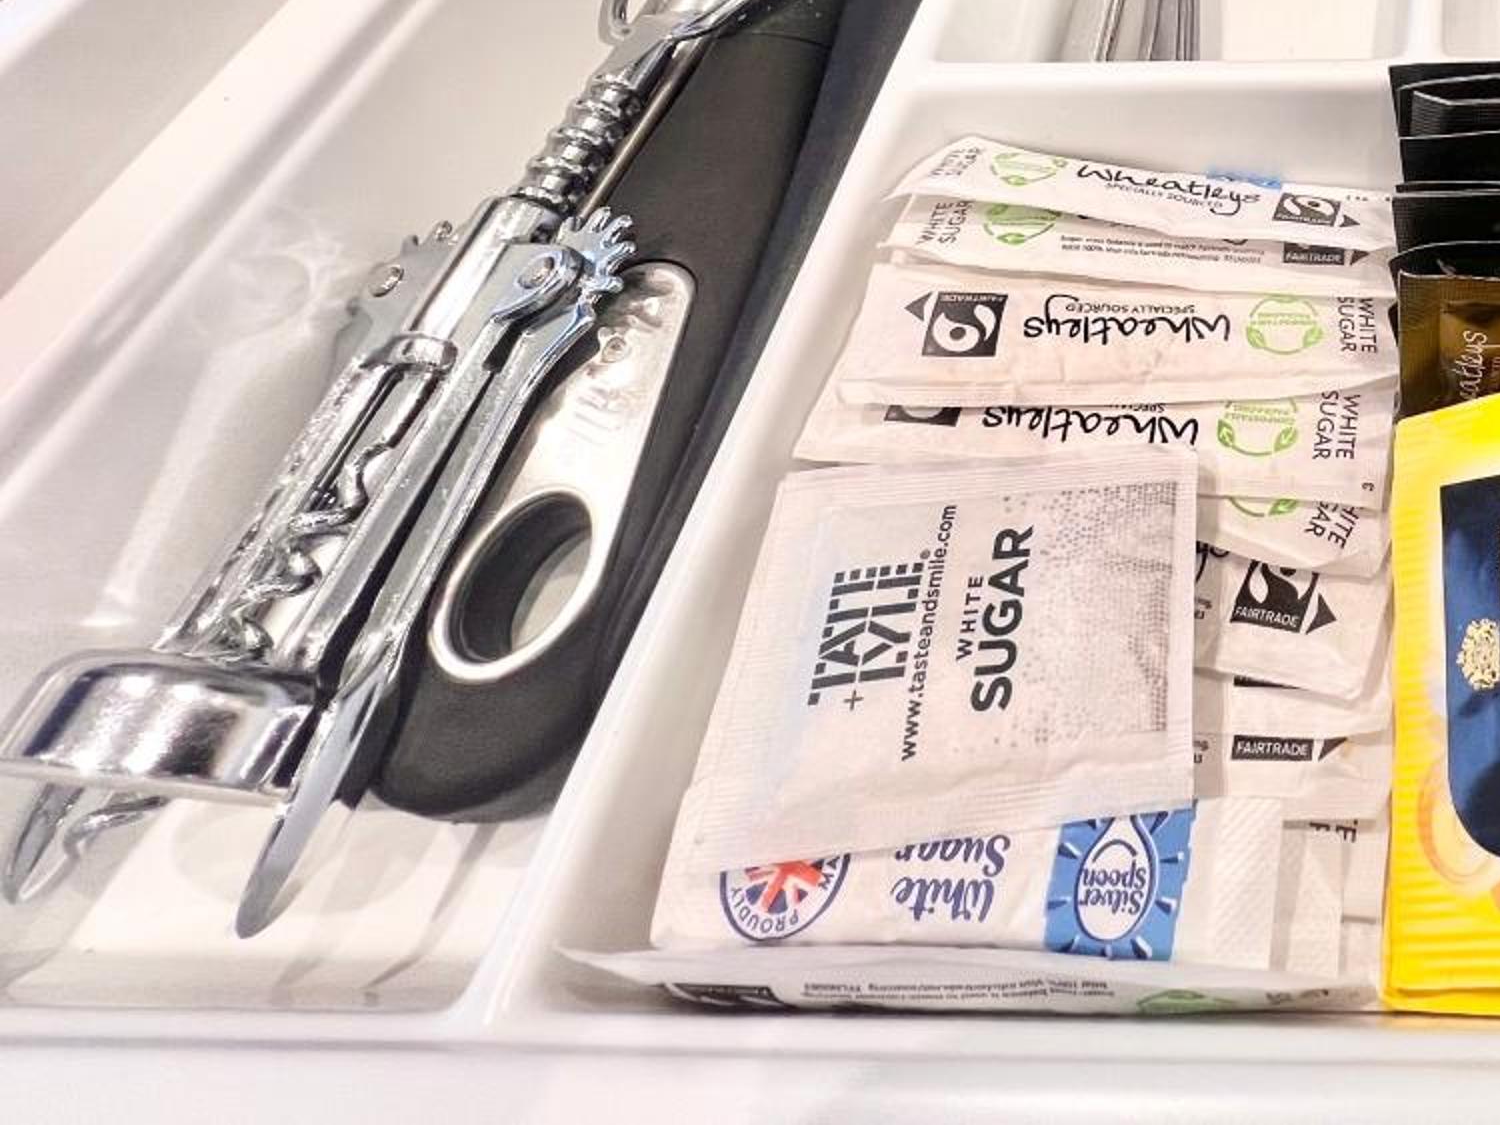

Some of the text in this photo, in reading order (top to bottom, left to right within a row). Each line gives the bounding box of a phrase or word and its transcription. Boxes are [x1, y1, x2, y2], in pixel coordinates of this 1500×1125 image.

[915, 201, 953, 246] WHITE
[1023, 293, 1231, 346] Wheatleys
[1065, 302, 1196, 315] SPECIALLY SOURCED
[1336, 296, 1358, 352] SUGAR
[1358, 296, 1379, 354] WHITE
[1312, 389, 1340, 460] SUGAR
[1335, 393, 1361, 460] WHITE
[1328, 506, 1360, 550] HITE
[807, 566, 878, 706] TATE
[857, 561, 925, 683] LYLE
[901, 504, 957, 762] www.tasteandsmile.com
[956, 575, 983, 661] WHITE
[970, 525, 1035, 713] SUGAR
[1233, 606, 1299, 628] FAIRTRADE
[1235, 740, 1310, 757] FAIRTRADE
[730, 885, 800, 934] PROUDLY
[889, 876, 996, 923] White
[1079, 888, 1145, 916] Silver
